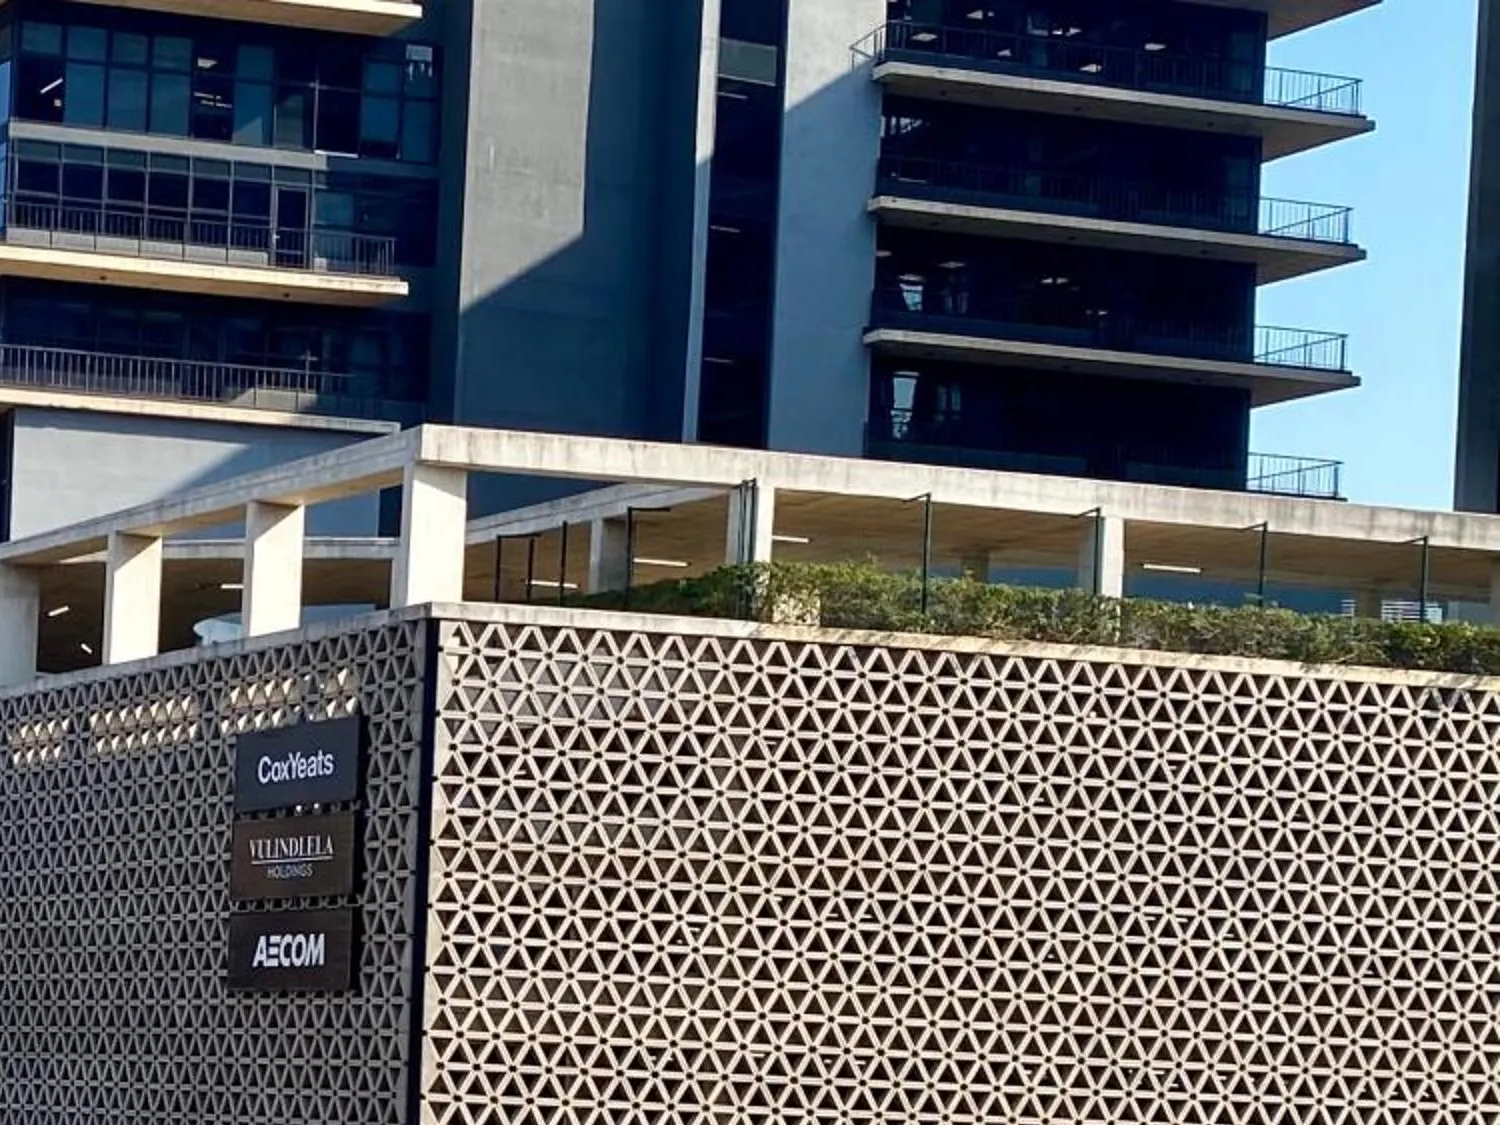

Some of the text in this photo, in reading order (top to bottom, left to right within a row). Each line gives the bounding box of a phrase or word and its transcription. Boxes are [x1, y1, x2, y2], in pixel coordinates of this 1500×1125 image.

[258, 750, 334, 784] CoxYeats
[249, 835, 334, 859] VULINDLELA
[267, 863, 313, 879] HOLDINGS
[252, 933, 326, 968] AECOM
